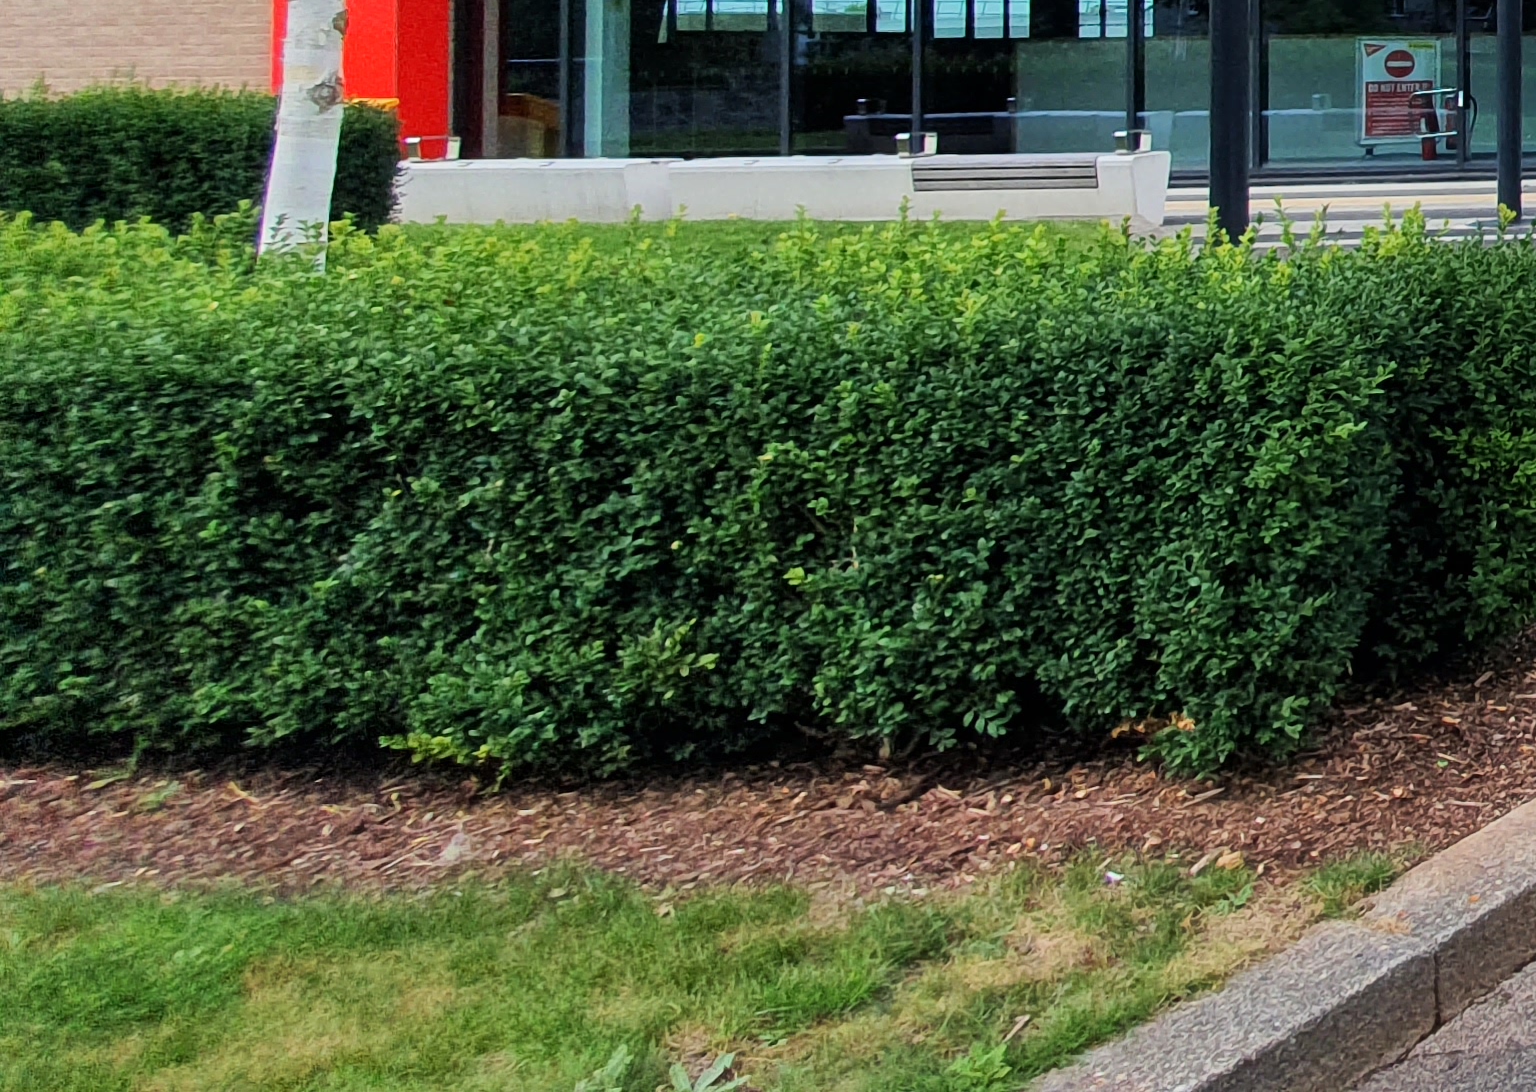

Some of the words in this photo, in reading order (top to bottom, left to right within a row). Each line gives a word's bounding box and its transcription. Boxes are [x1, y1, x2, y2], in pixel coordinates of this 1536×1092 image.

[1368, 83, 1379, 93] DO
[1380, 83, 1395, 93] NOT
[1396, 82, 1420, 92] ENTER
